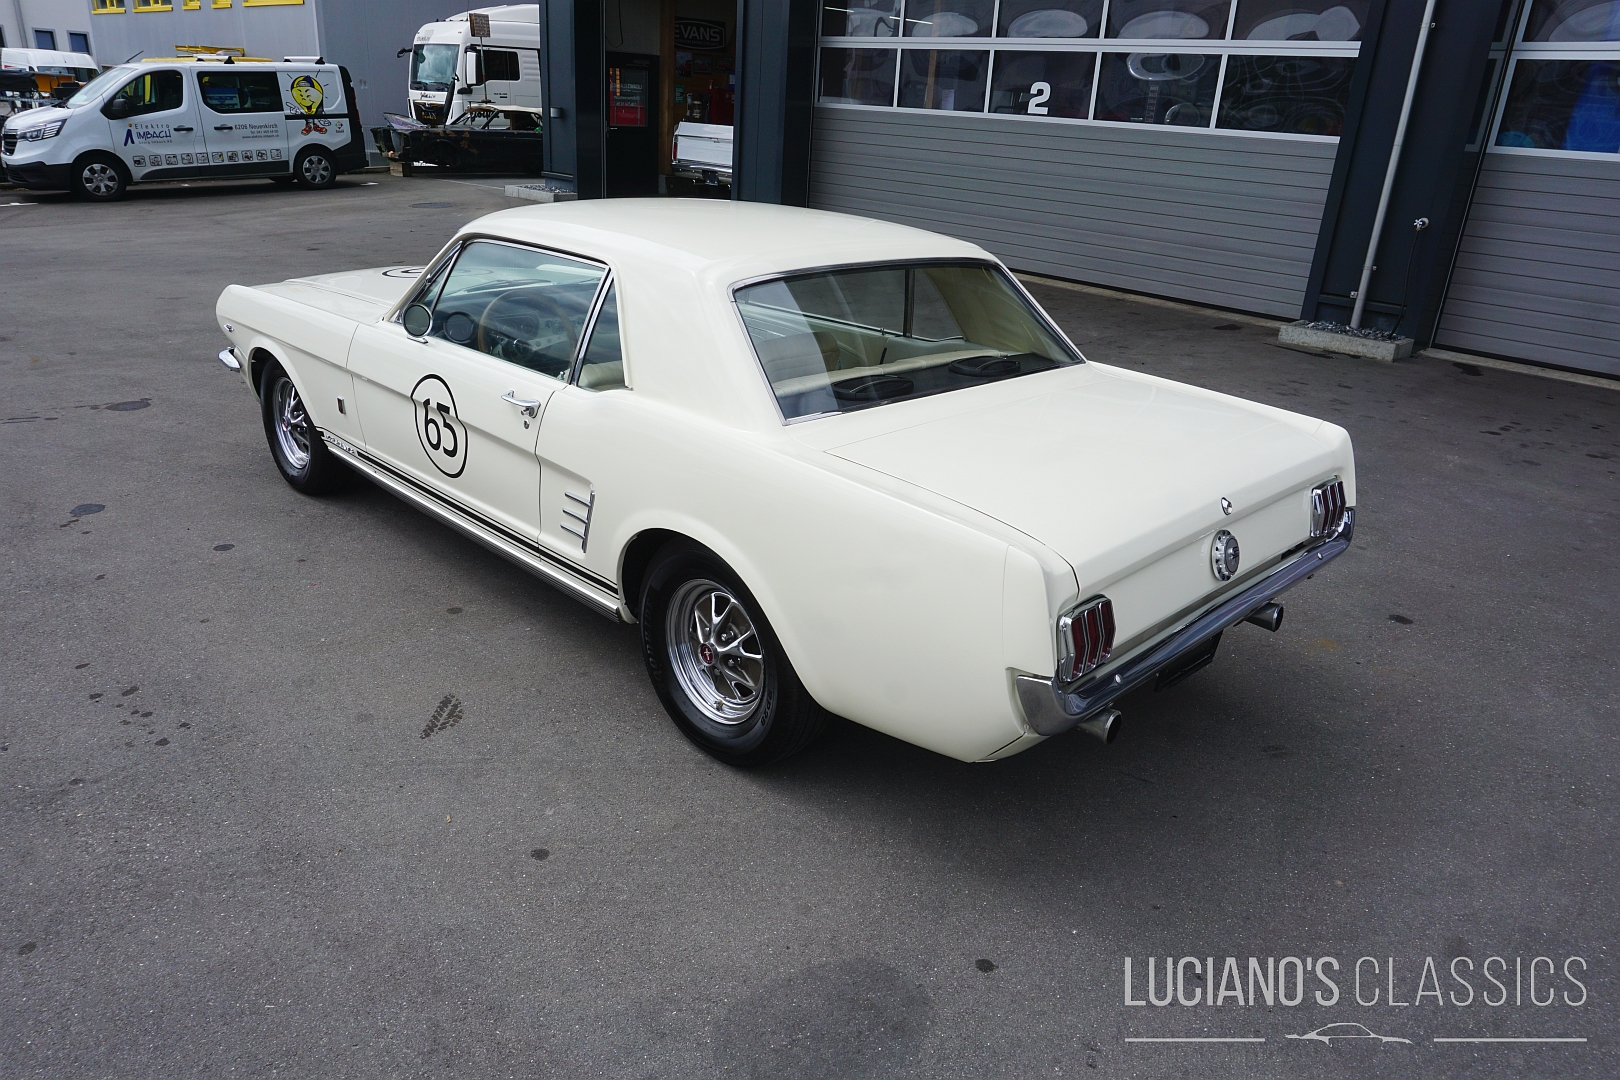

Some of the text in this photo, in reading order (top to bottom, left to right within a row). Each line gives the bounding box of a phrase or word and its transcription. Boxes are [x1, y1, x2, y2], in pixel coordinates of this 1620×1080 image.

[1028, 81, 1051, 115] 2
[248, 122, 279, 130] Neuenkirch
[422, 397, 458, 458] 65
